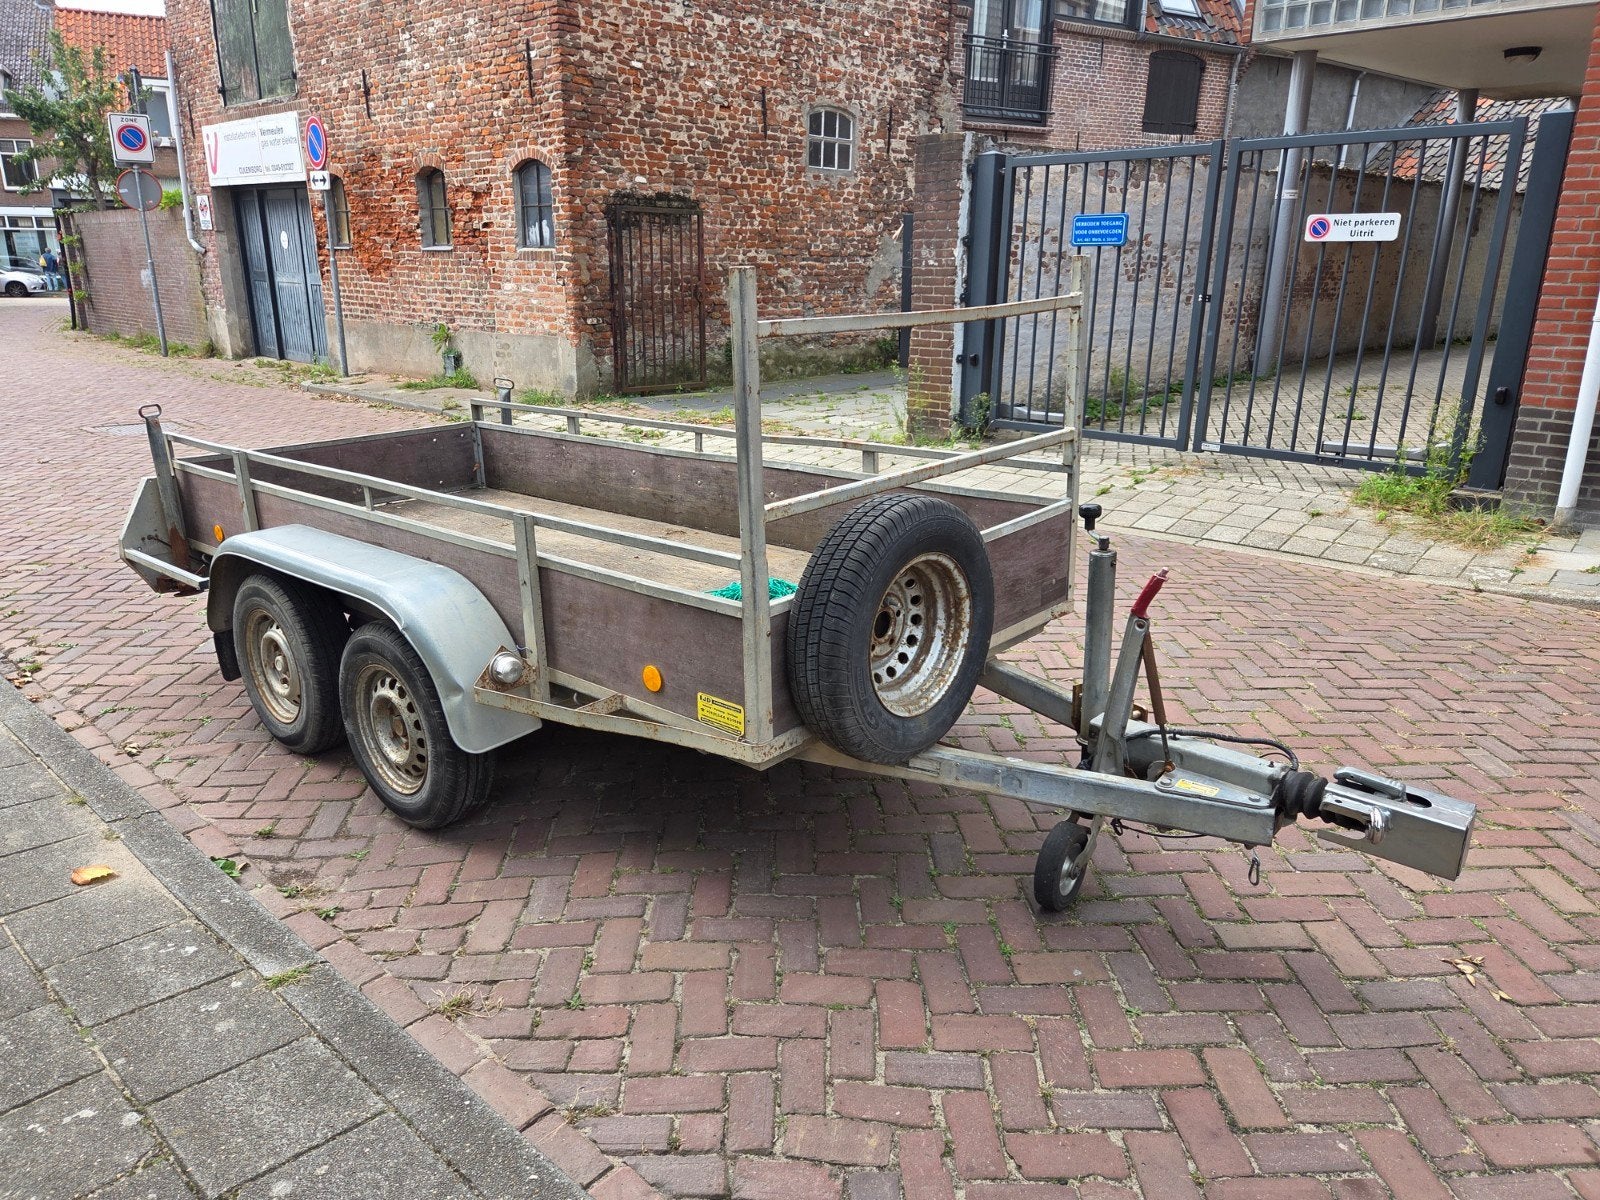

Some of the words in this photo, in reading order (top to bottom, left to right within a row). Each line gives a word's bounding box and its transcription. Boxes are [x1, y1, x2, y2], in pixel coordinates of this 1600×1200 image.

[1333, 219, 1352, 227] Niet
[1354, 218, 1395, 228] parkeren
[1349, 230, 1375, 238] Uitrit
